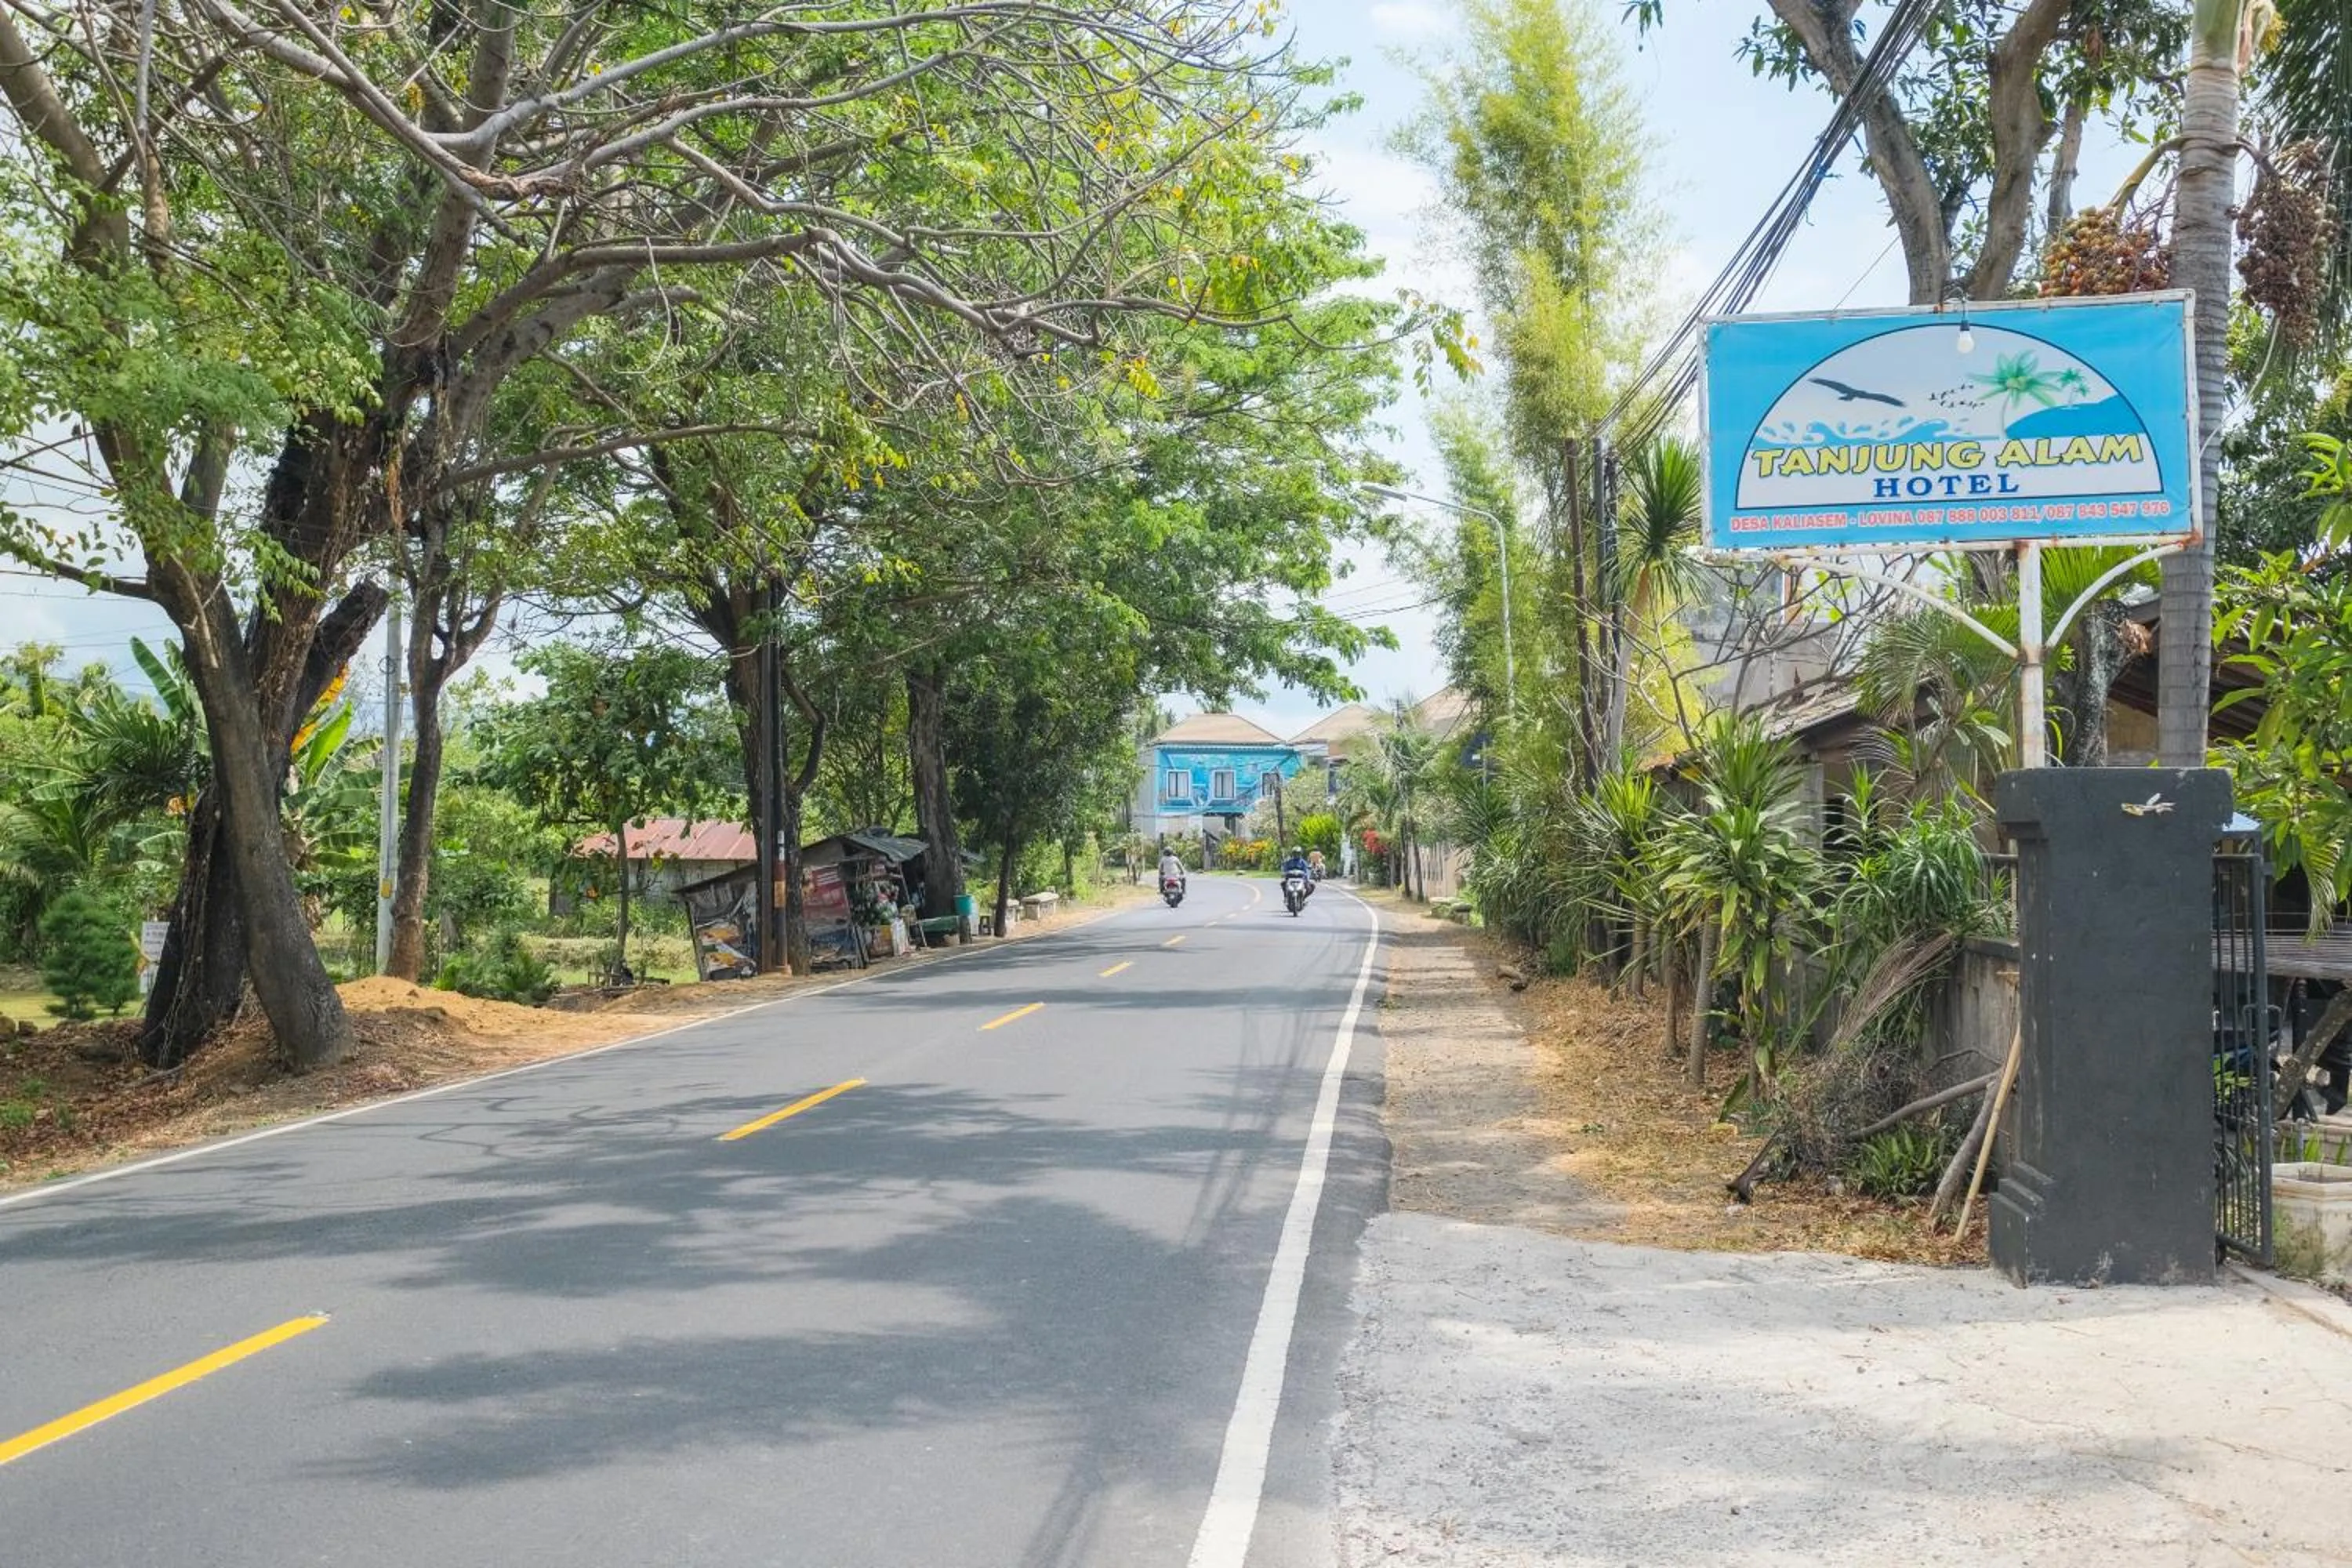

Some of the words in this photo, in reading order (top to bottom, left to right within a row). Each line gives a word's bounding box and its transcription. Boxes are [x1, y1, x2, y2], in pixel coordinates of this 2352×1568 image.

[1752, 441, 1985, 477] TANJUNG
[1995, 434, 2143, 468] ALAM
[1874, 474, 2020, 497] HOTEL
[1731, 516, 1769, 532] DESA
[1772, 513, 1847, 530] KALIASEM
[1859, 510, 1913, 527] LOVINA
[1916, 510, 1944, 524] 087
[1947, 508, 1976, 524] 888
[1980, 506, 2008, 522] 003
